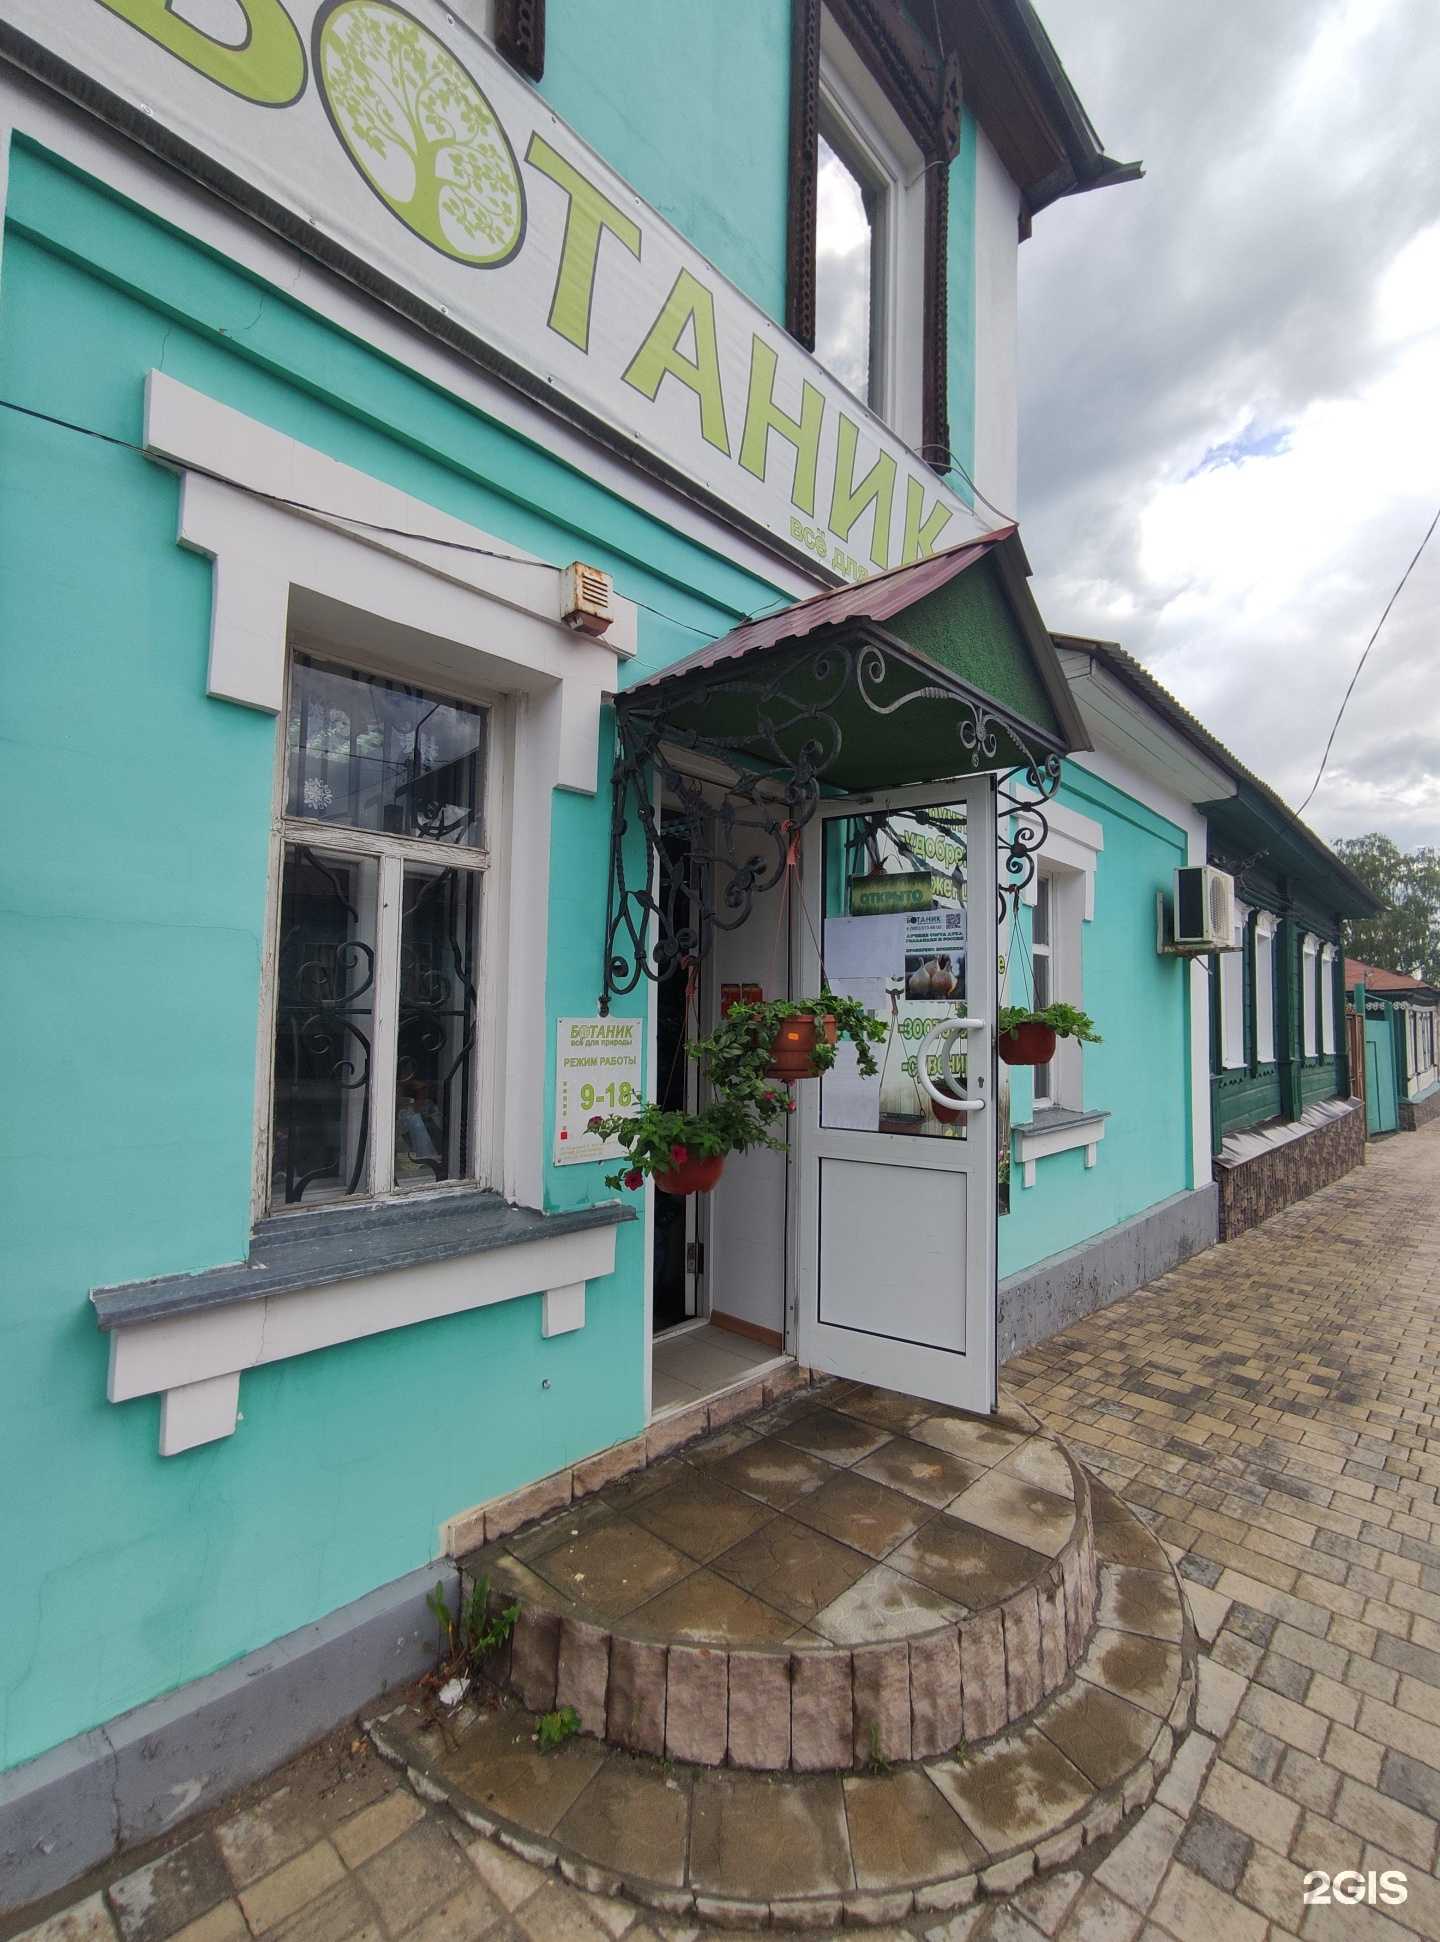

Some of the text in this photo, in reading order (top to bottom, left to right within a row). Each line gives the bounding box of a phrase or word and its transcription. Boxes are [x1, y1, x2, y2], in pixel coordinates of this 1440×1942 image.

[571, 1024, 633, 1039] БОТАНИК
[564, 1055, 636, 1067] РЕЖИМ РАБОТЫ
[581, 1082, 632, 1110] 9-18
